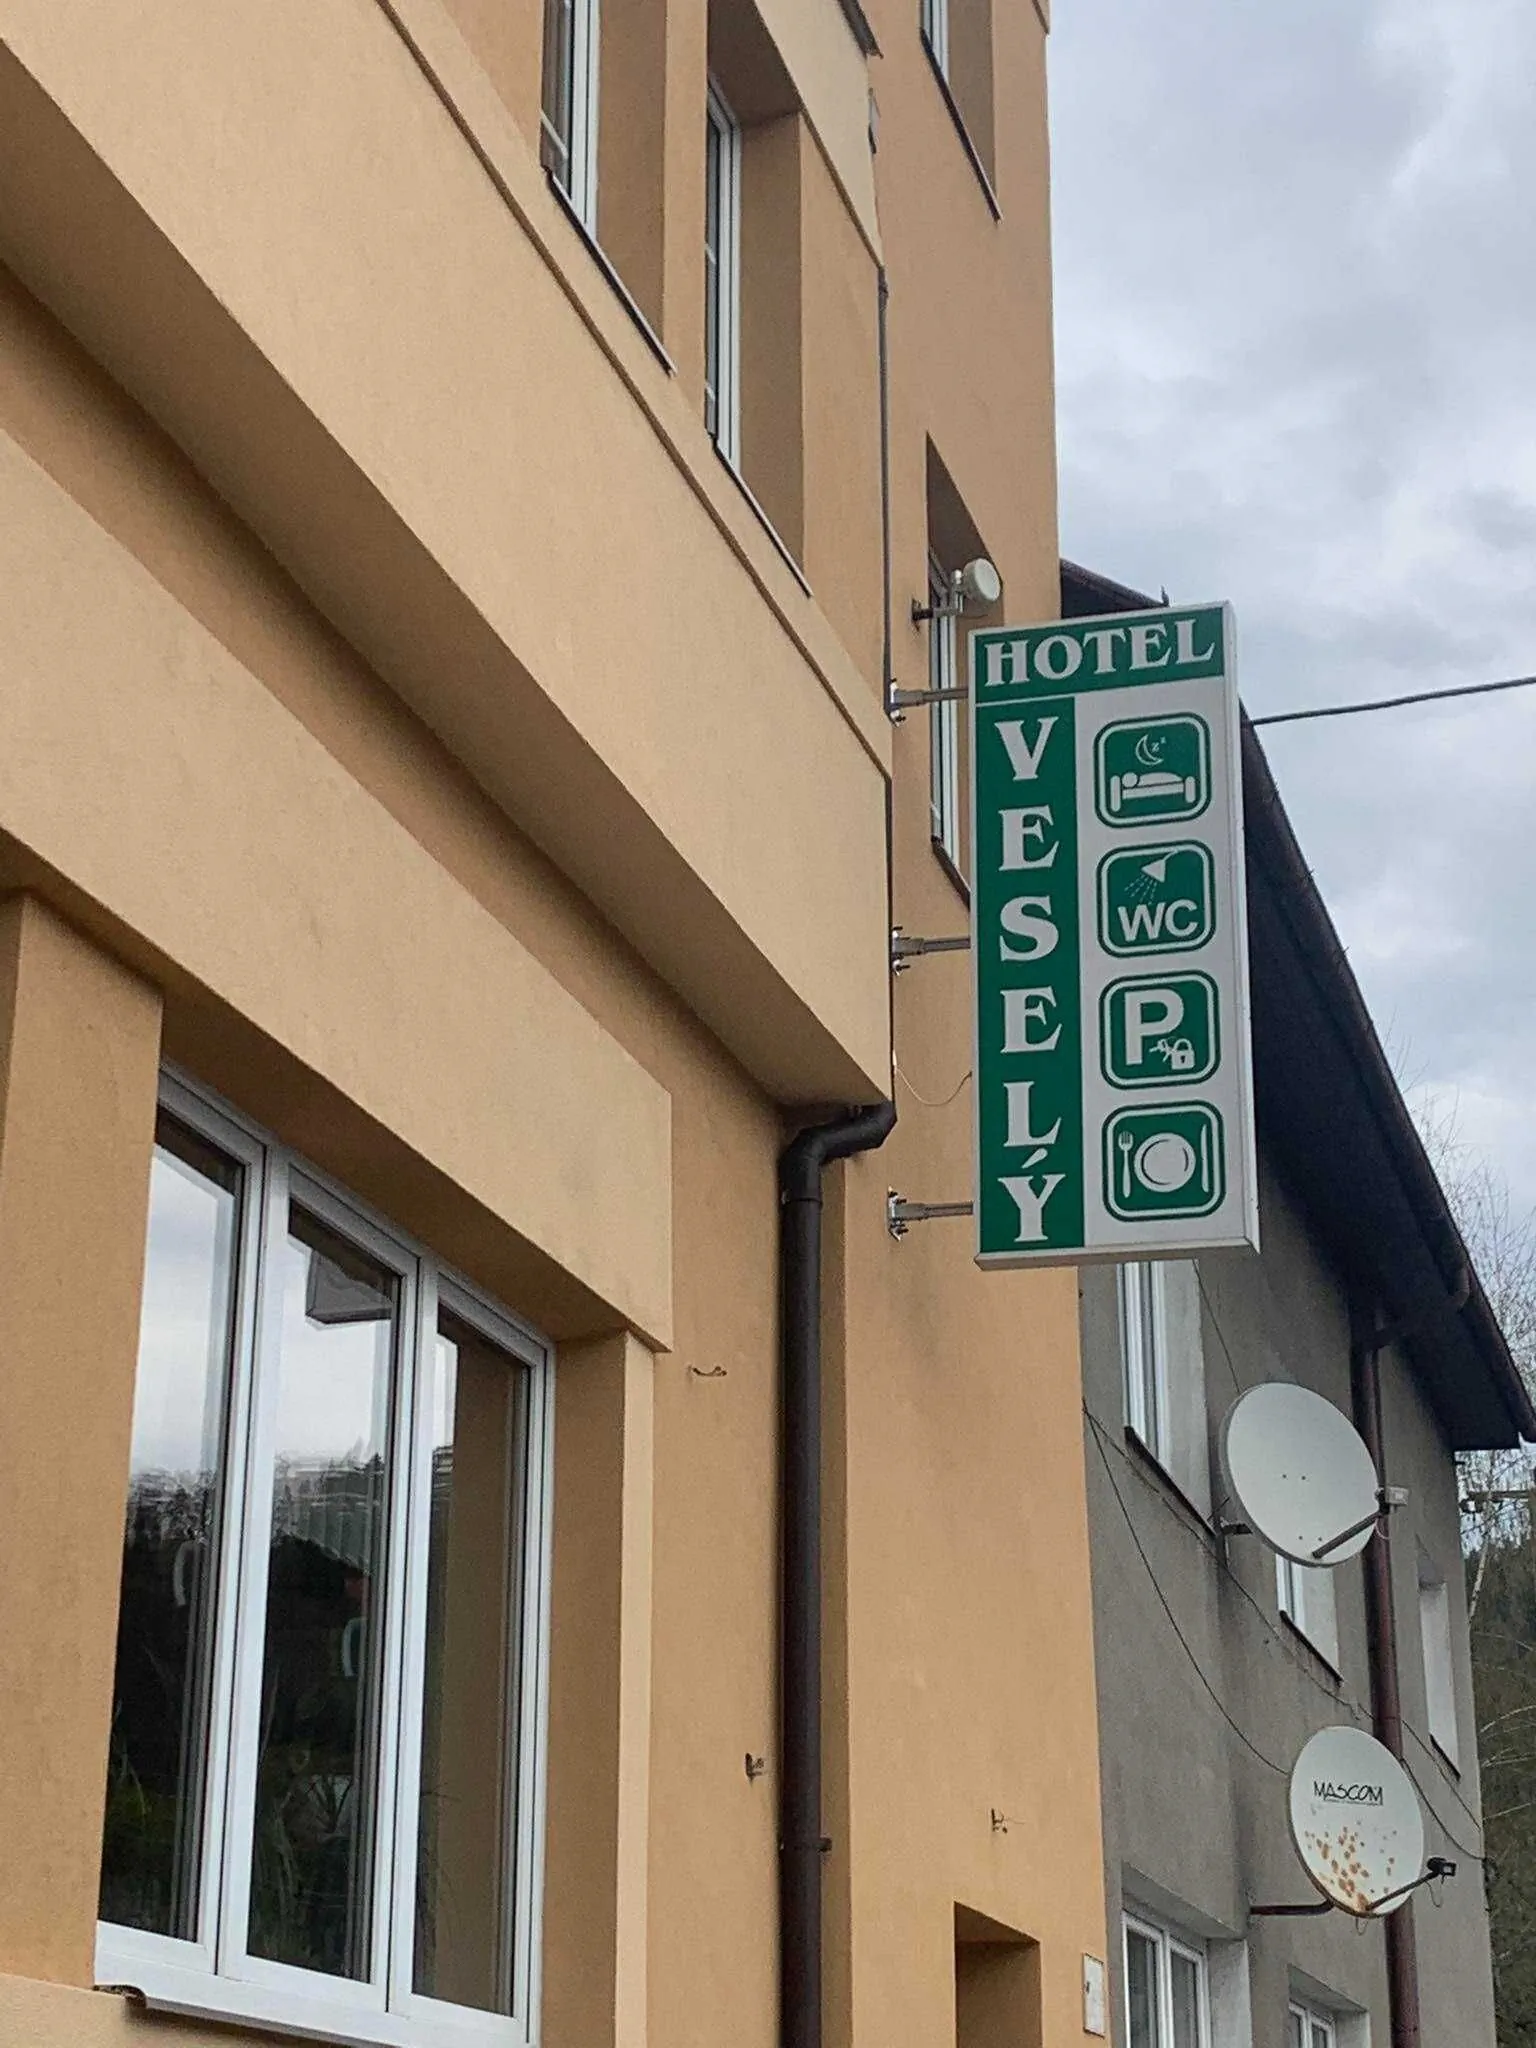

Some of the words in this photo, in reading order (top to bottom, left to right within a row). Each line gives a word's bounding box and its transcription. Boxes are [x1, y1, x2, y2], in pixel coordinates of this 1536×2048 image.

[984, 619, 1215, 687] HOTEL
[1117, 899, 1198, 942] WC
[994, 716, 1066, 1243] VESELÝ
[1124, 988, 1184, 1066] P
[1313, 1781, 1384, 1805] MASCOM
